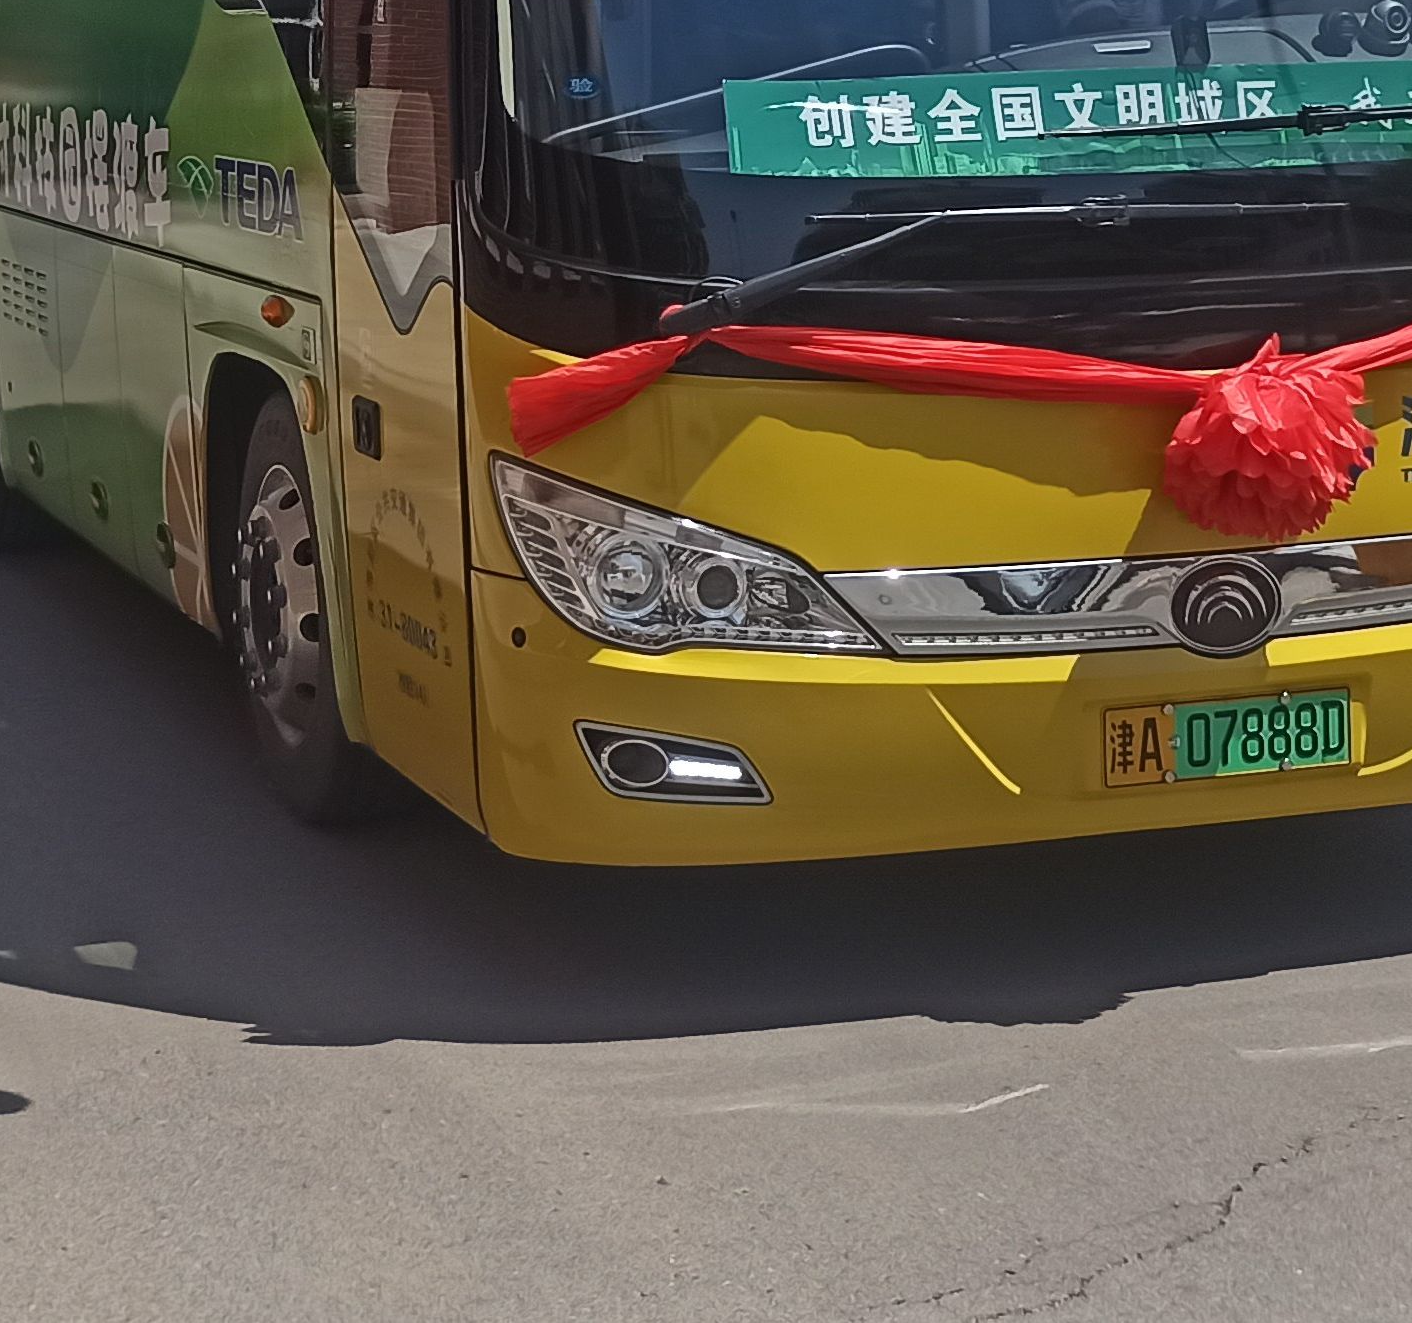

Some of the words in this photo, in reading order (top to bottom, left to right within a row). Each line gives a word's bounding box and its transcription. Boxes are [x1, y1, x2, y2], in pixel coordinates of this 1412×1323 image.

[799, 78, 1279, 148] 创建全国文明城区
[213, 154, 305, 244] TEDA
